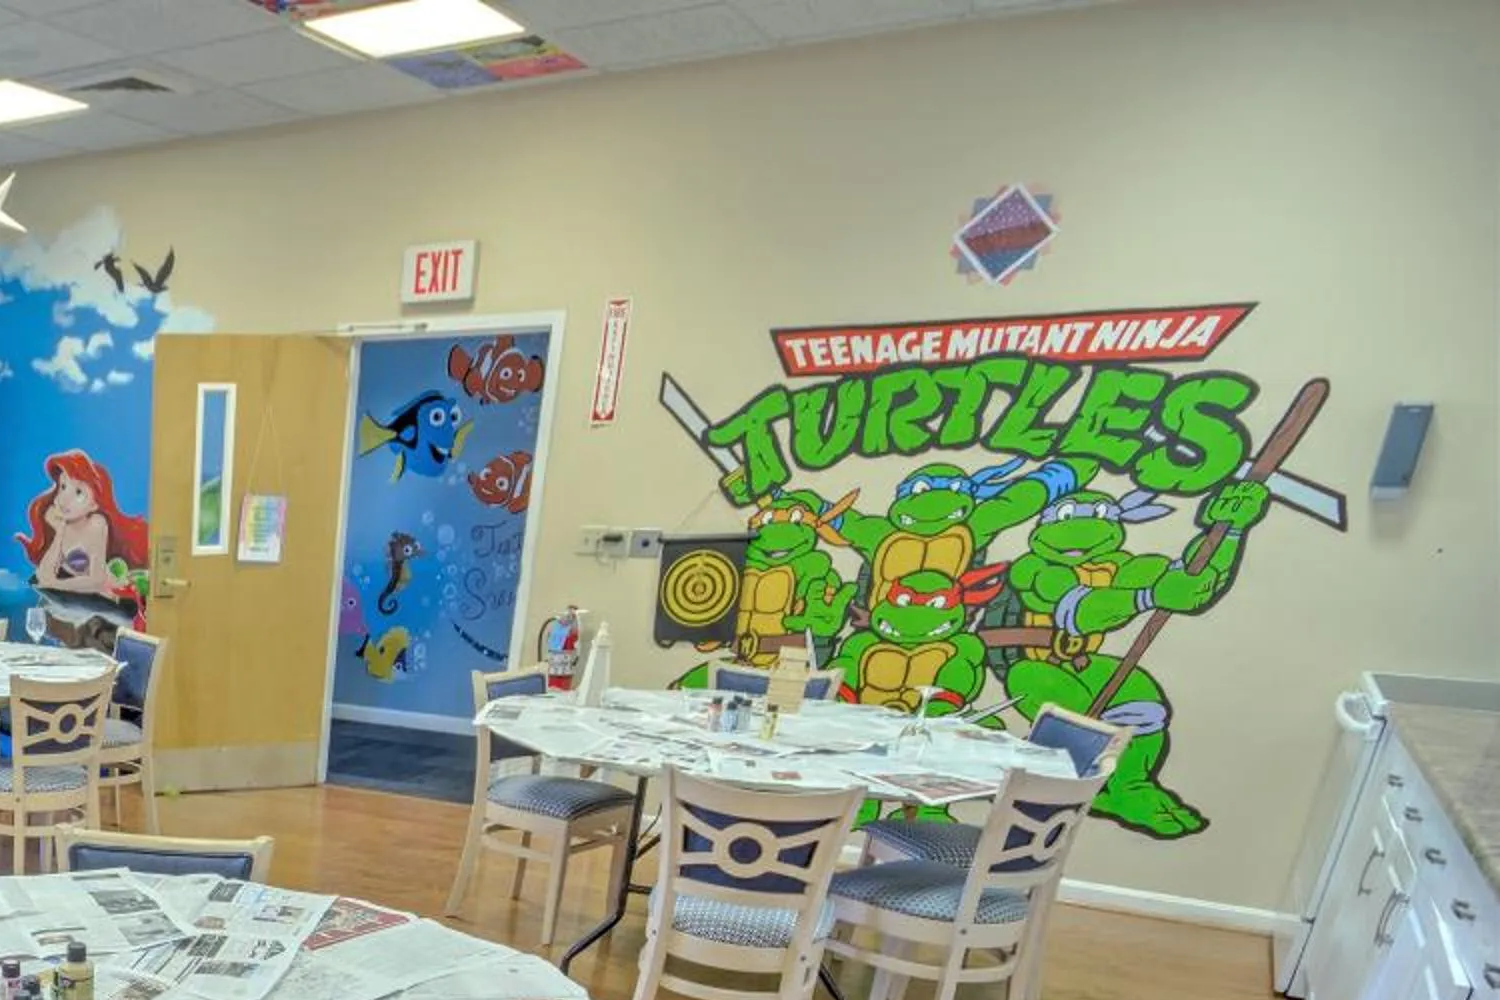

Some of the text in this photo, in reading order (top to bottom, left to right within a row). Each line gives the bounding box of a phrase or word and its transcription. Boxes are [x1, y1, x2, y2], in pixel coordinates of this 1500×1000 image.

[414, 248, 463, 294] EXIT
[785, 309, 1221, 369] TEENAGE MUTANT NINJA
[704, 352, 1261, 499] TURTLES
